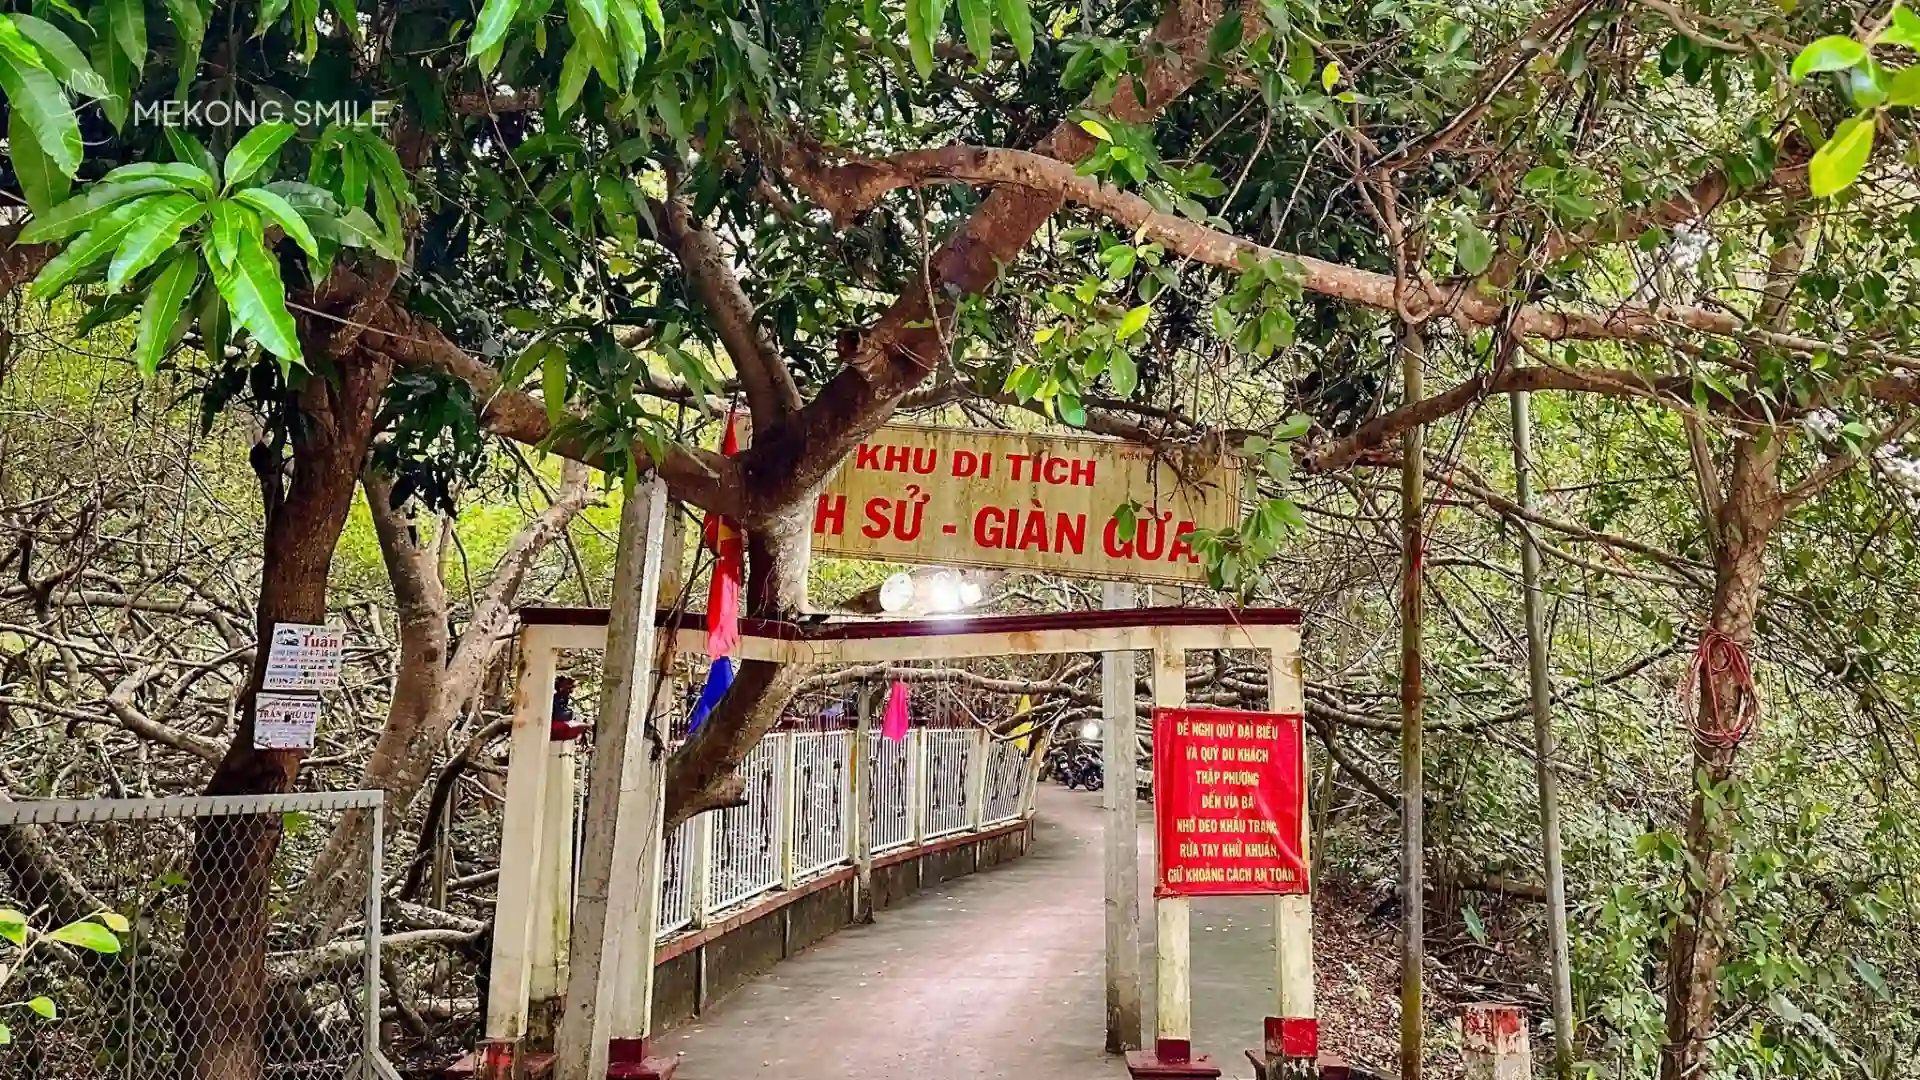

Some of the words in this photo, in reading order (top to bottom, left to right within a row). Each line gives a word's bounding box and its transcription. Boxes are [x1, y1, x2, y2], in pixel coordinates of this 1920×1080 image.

[856, 443, 937, 475] KHU
[952, 450, 992, 480] DI
[861, 484, 931, 542] SỬ
[974, 498, 1086, 555] GIÀN
[1201, 843, 1219, 857] TAY
[1254, 868, 1268, 882] AN
